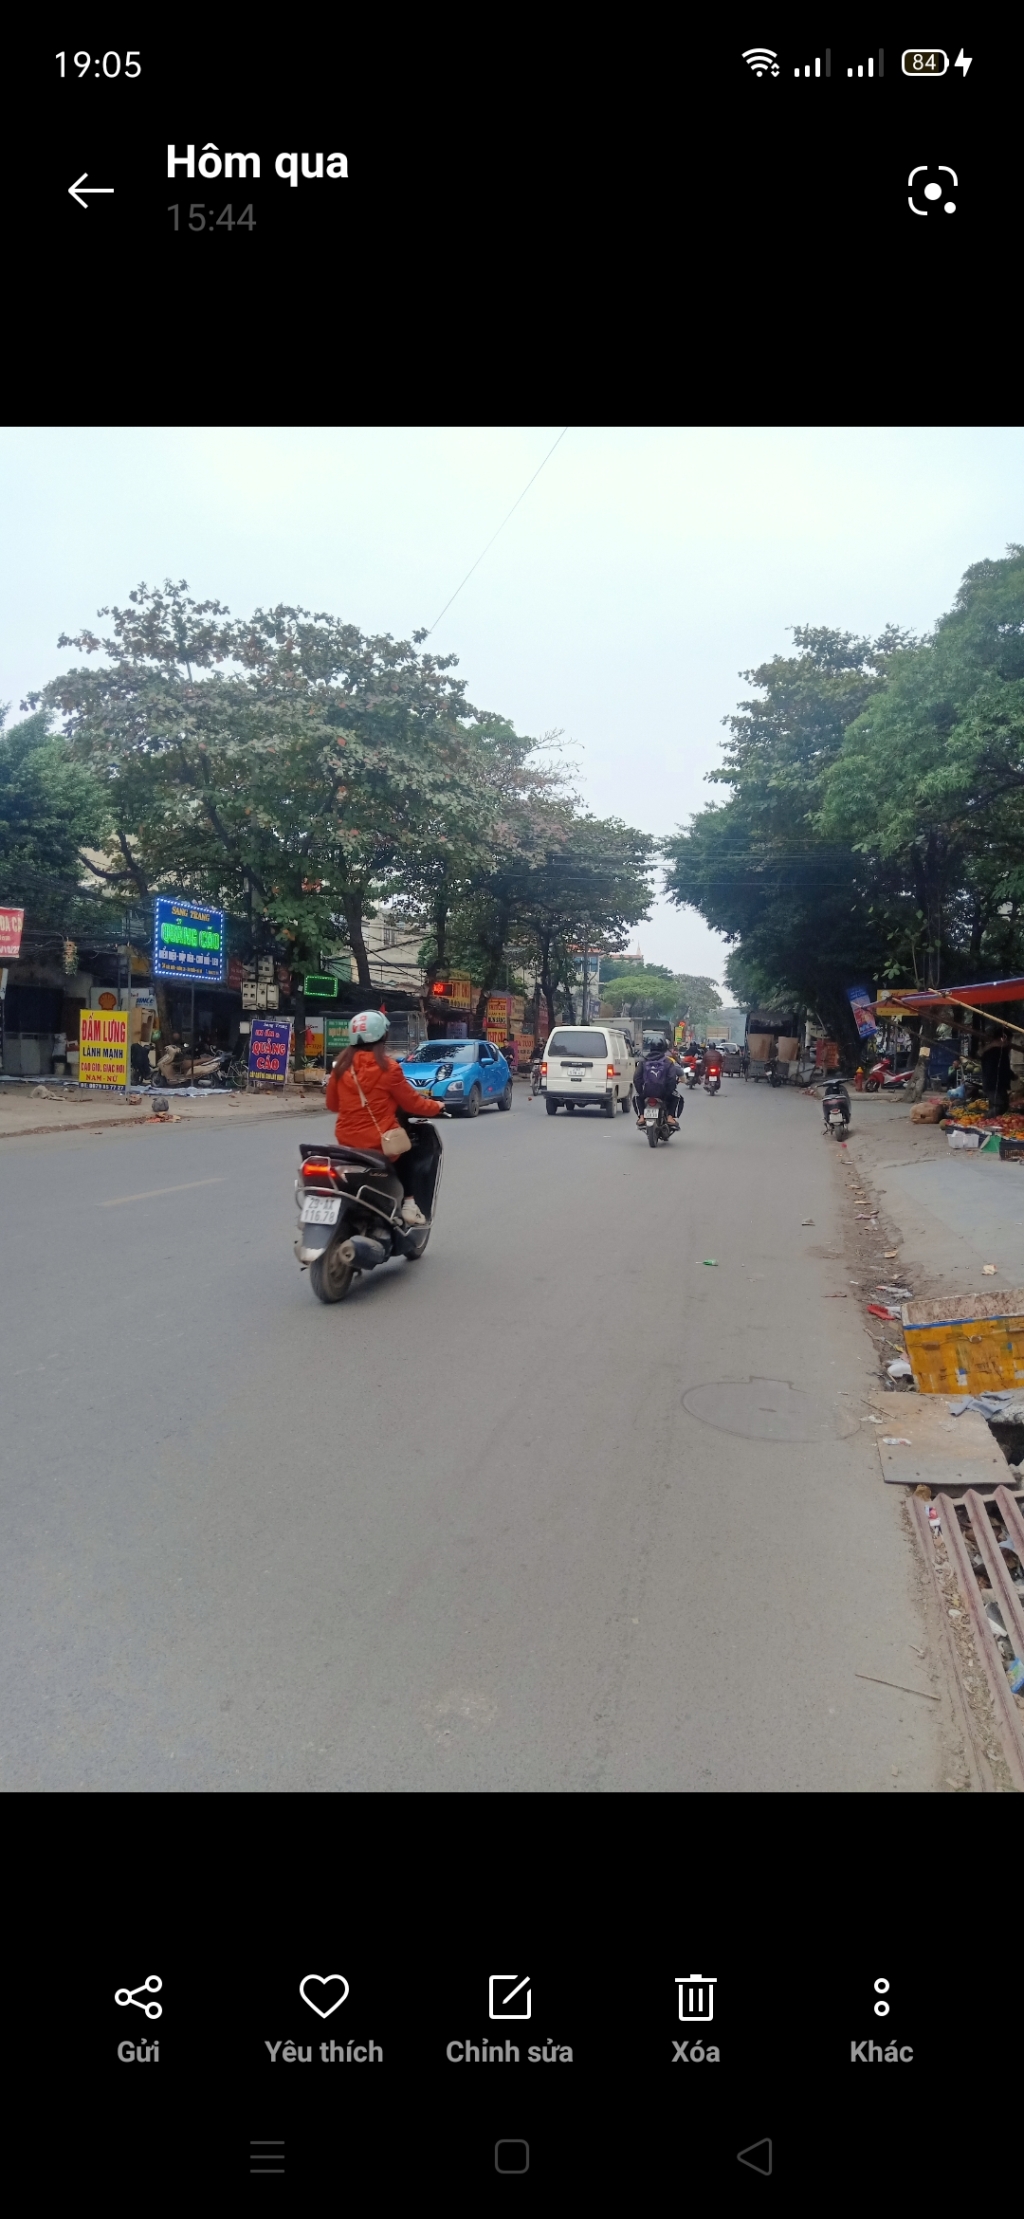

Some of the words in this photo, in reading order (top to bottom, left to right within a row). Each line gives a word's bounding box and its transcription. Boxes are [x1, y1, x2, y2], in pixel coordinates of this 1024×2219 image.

[161, 918, 198, 947] QUẢNG
[198, 926, 220, 950] CÁO
[82, 1013, 101, 1041] ĐẤM
[103, 1019, 126, 1043] LƯNG
[83, 1045, 101, 1057] LÀNH
[103, 1048, 123, 1060] MẠNH
[252, 1038, 286, 1056] QUẢNG
[256, 1055, 280, 1071] CÁO
